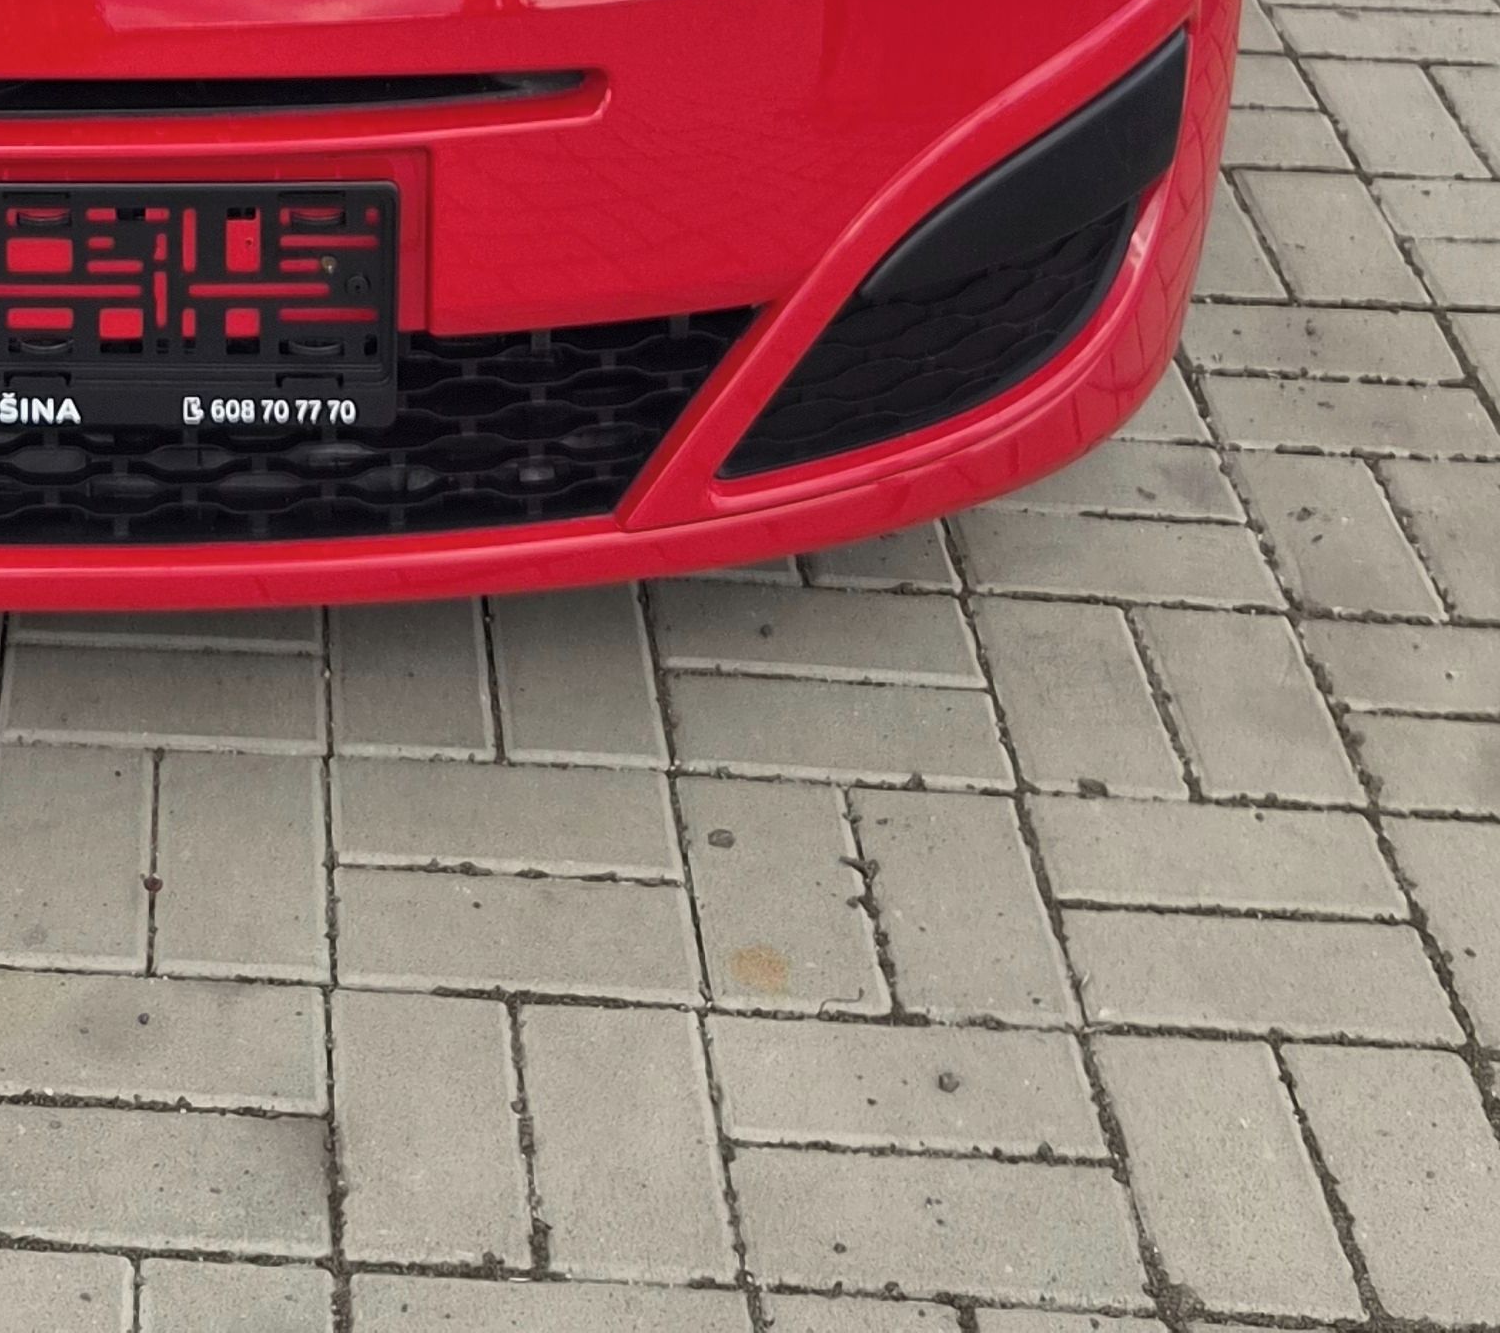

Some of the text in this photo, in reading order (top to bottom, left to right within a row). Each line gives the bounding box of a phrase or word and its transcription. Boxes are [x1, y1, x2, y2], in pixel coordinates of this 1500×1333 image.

[211, 398, 356, 425] 608 70 77 70
